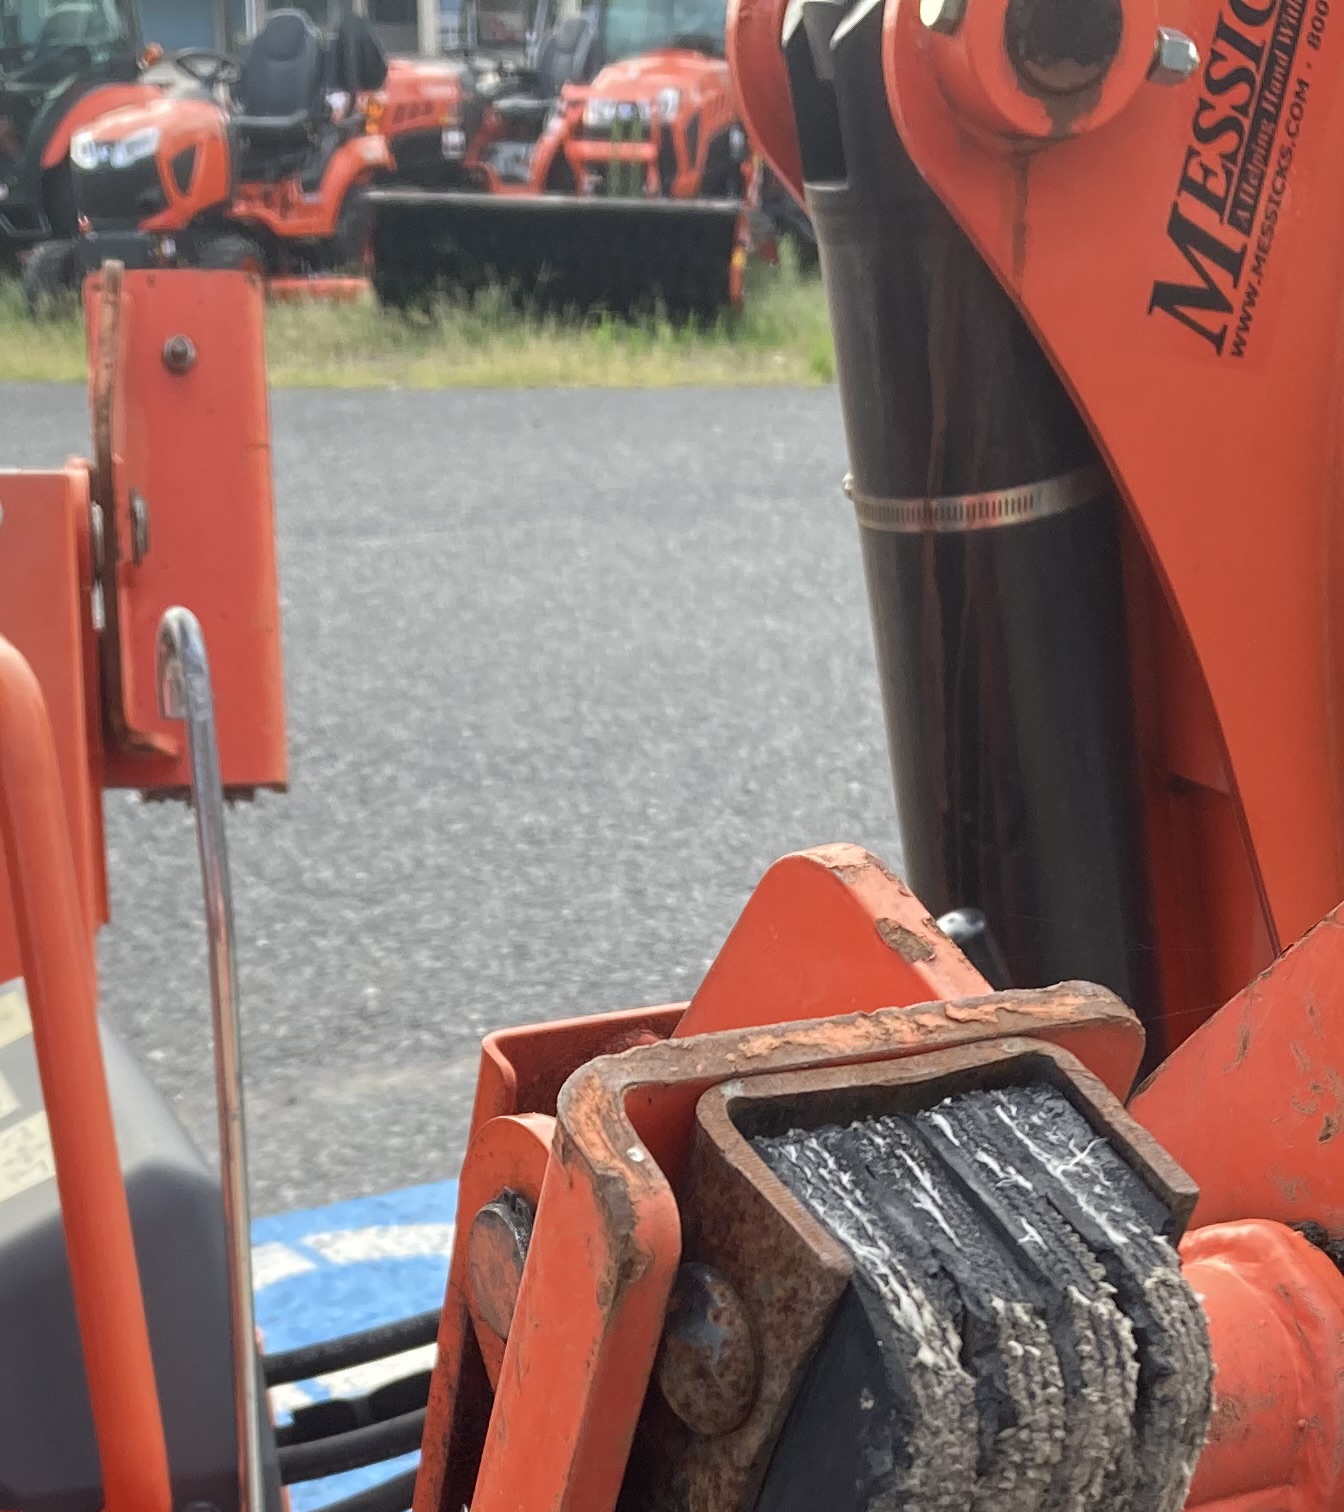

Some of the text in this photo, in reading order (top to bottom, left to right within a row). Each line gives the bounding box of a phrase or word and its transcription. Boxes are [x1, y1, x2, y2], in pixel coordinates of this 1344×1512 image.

[1229, 78, 1311, 358] WWW.MESSICKS.COM
[1239, 117, 1277, 205] Helping
[1260, 48, 1290, 113] Hand
